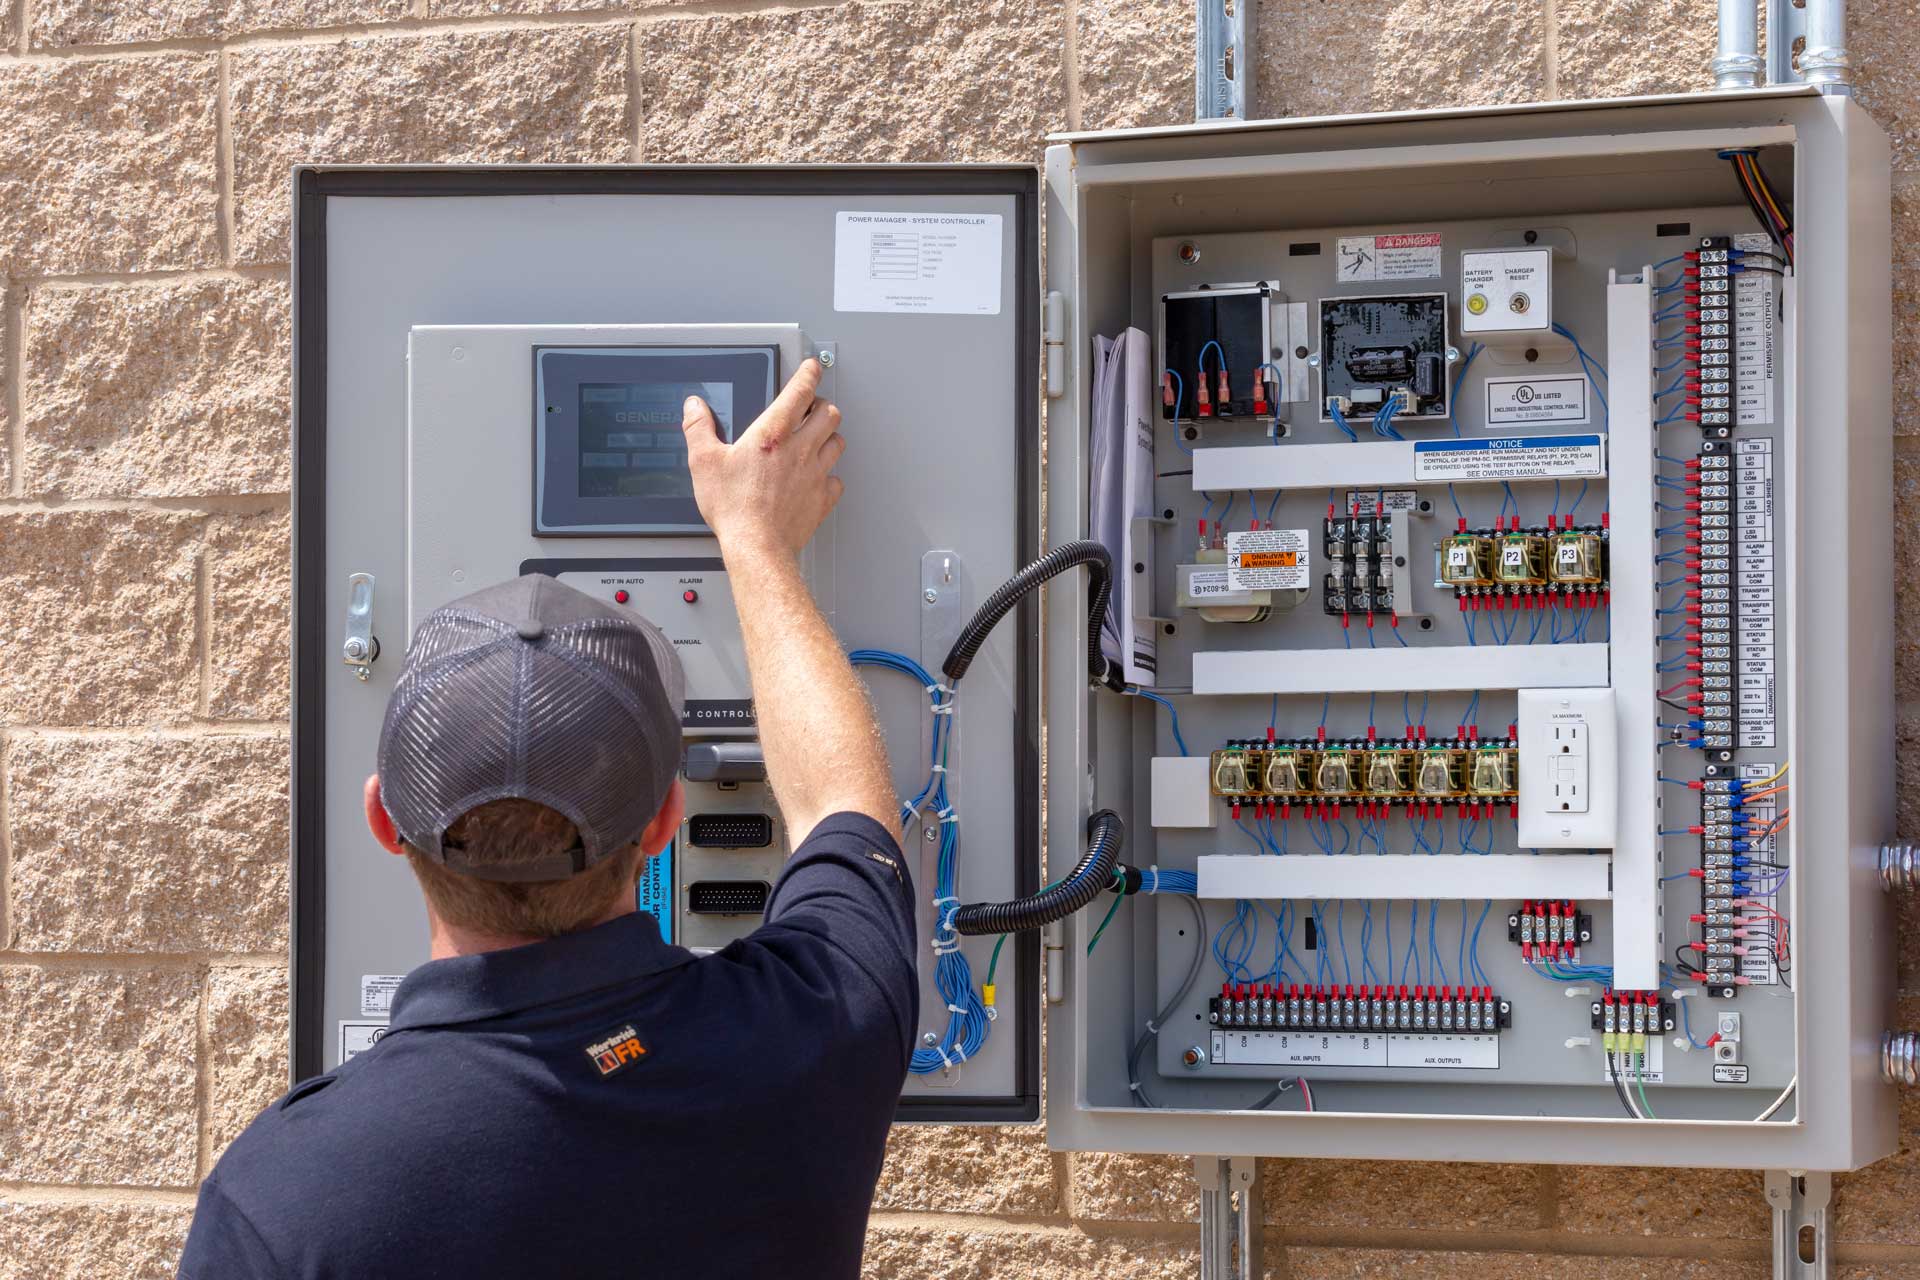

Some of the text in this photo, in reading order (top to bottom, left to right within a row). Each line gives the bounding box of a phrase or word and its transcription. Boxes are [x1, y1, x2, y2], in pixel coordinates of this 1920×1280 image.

[1395, 237, 1432, 246] DANGER
[1764, 291, 1772, 329] OUTPUTS
[1489, 440, 1523, 449] NOTICE
[1466, 470, 1481, 478] SEE
[1516, 468, 1547, 476] MANUAL
[1453, 553, 1464, 562] P1
[1506, 552, 1519, 562] P2
[1561, 550, 1575, 560] P3
[585, 1028, 637, 1057] Workrite
[613, 1038, 646, 1064] FR
